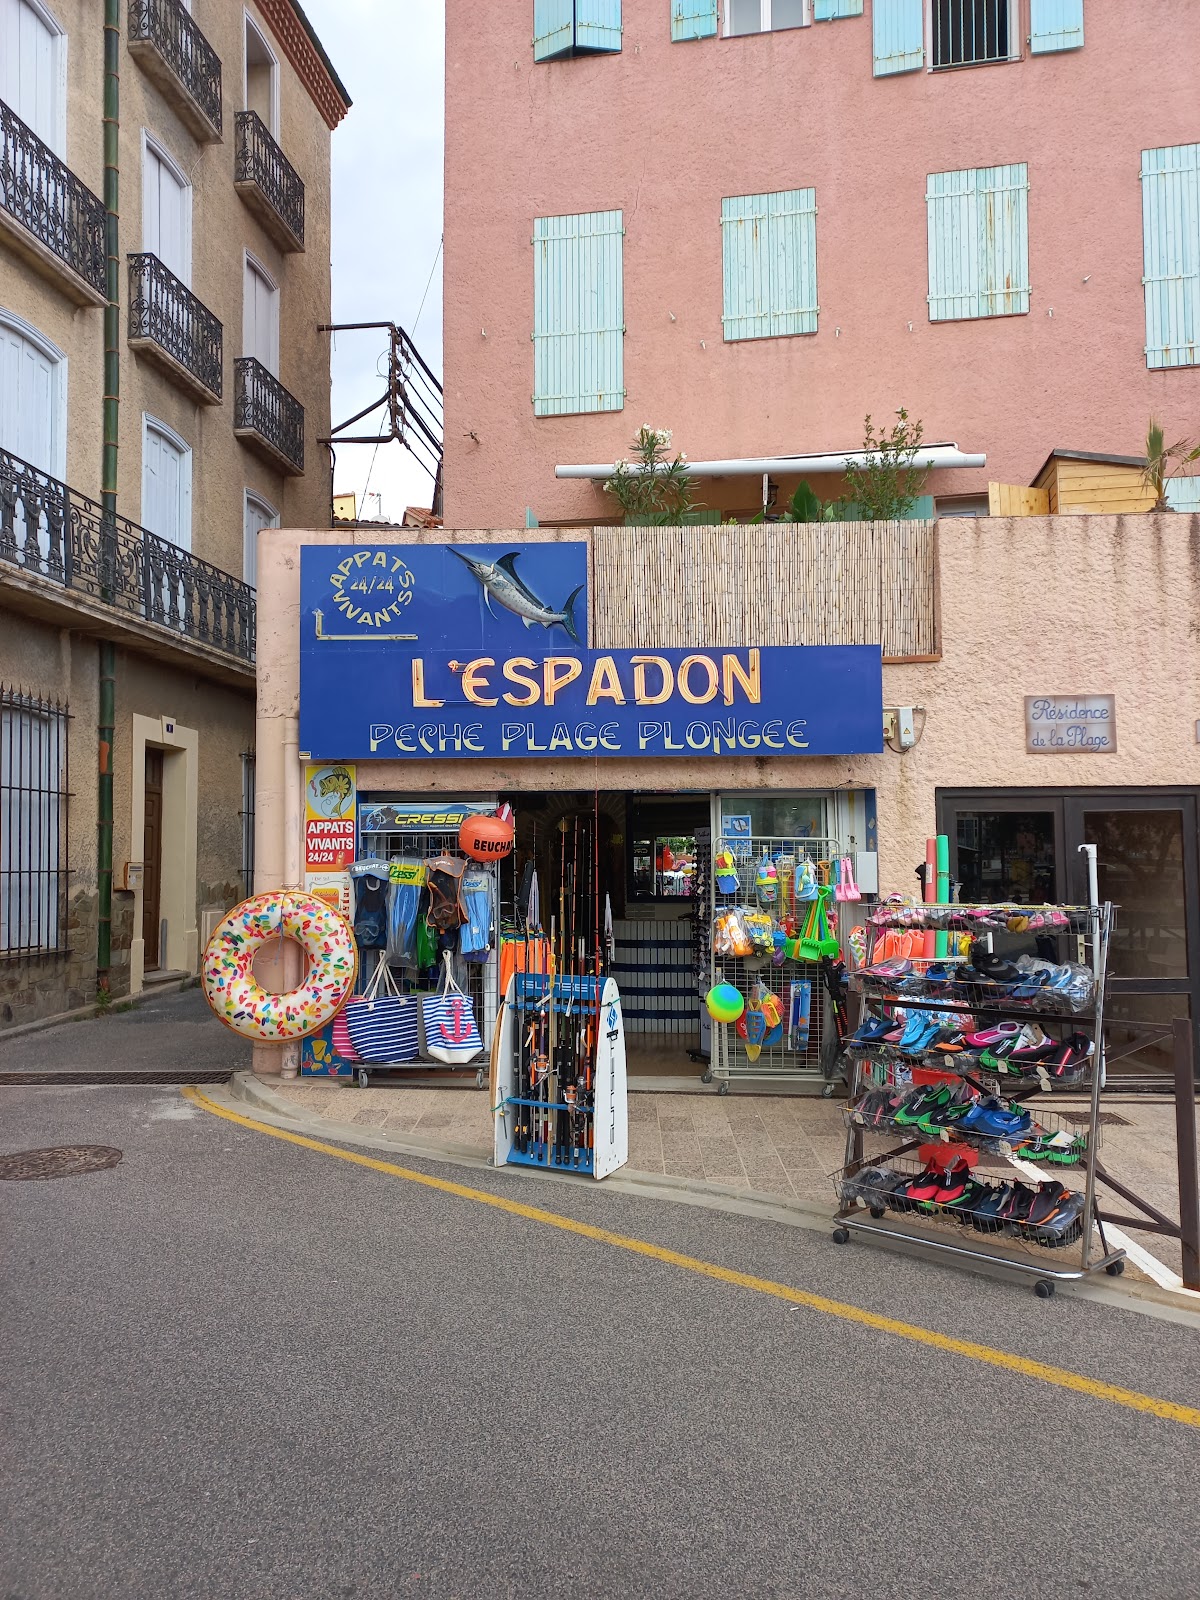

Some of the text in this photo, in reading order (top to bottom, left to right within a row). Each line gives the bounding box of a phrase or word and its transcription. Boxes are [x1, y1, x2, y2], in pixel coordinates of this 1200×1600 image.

[330, 551, 415, 589] APPATS
[350, 575, 394, 594] 24/24
[332, 589, 413, 628] VIVANTS
[1032, 699, 1110, 721] Résidence
[369, 716, 809, 754] PECHE PLAGE PLONGEE
[1032, 725, 1110, 752] de la Plage
[307, 821, 354, 834] APPATS
[394, 813, 464, 825] CRESSI
[307, 837, 354, 850] VIVANTS
[307, 851, 334, 863] 24/24
